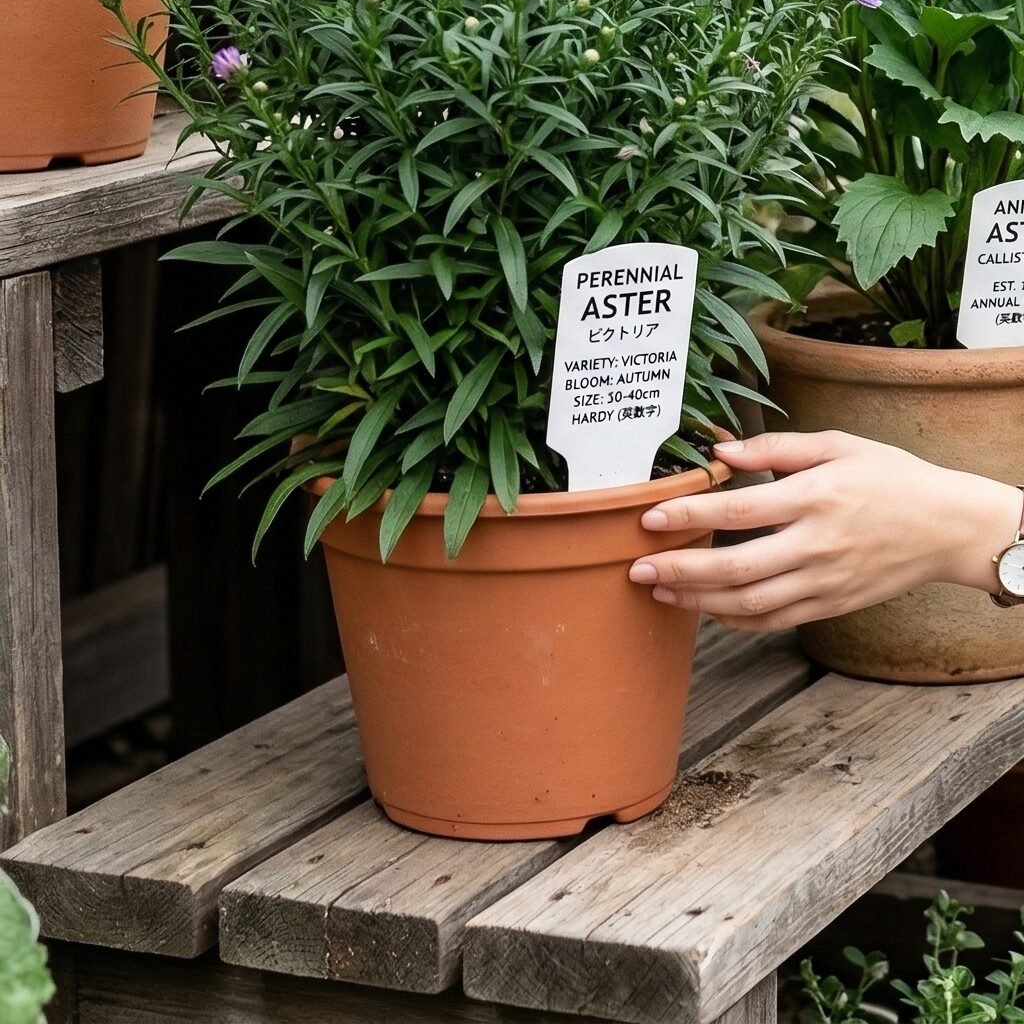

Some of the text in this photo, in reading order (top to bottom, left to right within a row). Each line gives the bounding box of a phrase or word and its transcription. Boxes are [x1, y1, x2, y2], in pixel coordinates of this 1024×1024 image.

[577, 264, 684, 289] PERENNIAL
[993, 281, 1017, 292] EST.
[581, 289, 671, 321] ASTER
[970, 296, 1020, 309] ANNUAL
[564, 351, 677, 372] VARIETY: VICTORIA
[565, 369, 670, 391] BLOOM: AUTUMN
[573, 394, 604, 407] SIZE:
[572, 410, 614, 425] HARDY
